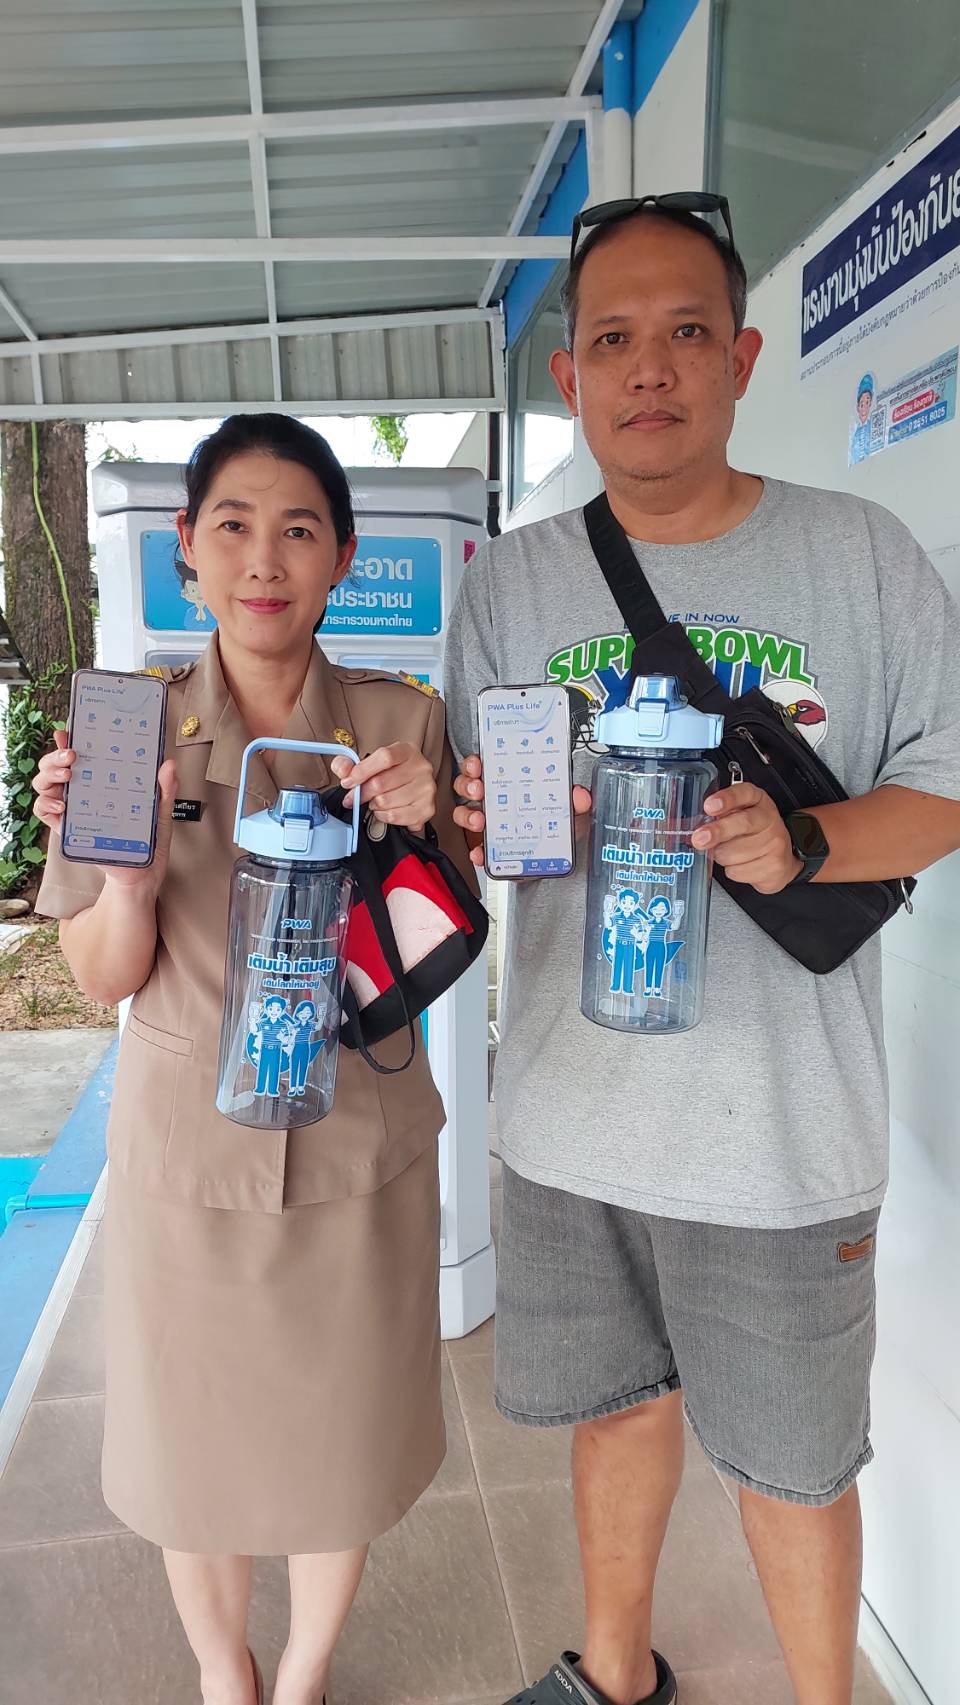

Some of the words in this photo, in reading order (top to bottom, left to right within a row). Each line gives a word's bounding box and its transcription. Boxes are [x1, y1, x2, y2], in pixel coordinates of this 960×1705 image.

[352, 557, 413, 580] ะอาด
[322, 613, 413, 627] กระทรวงมหาดไทย
[684, 612, 699, 623] IN
[703, 613, 740, 624] NOW
[546, 631, 637, 684] SUP
[686, 627, 813, 685] BOWL
[487, 704, 506, 712] PWA
[506, 703, 524, 711] Plus
[634, 807, 665, 819] PWA
[602, 843, 643, 866] เติมน้ำ
[645, 849, 694, 872] เติมสุข
[282, 919, 312, 929] PWA
[248, 952, 291, 973] เติมน้ำ
[293, 957, 336, 976] เติมสุข
[554, 1670, 573, 1694] ADDA
